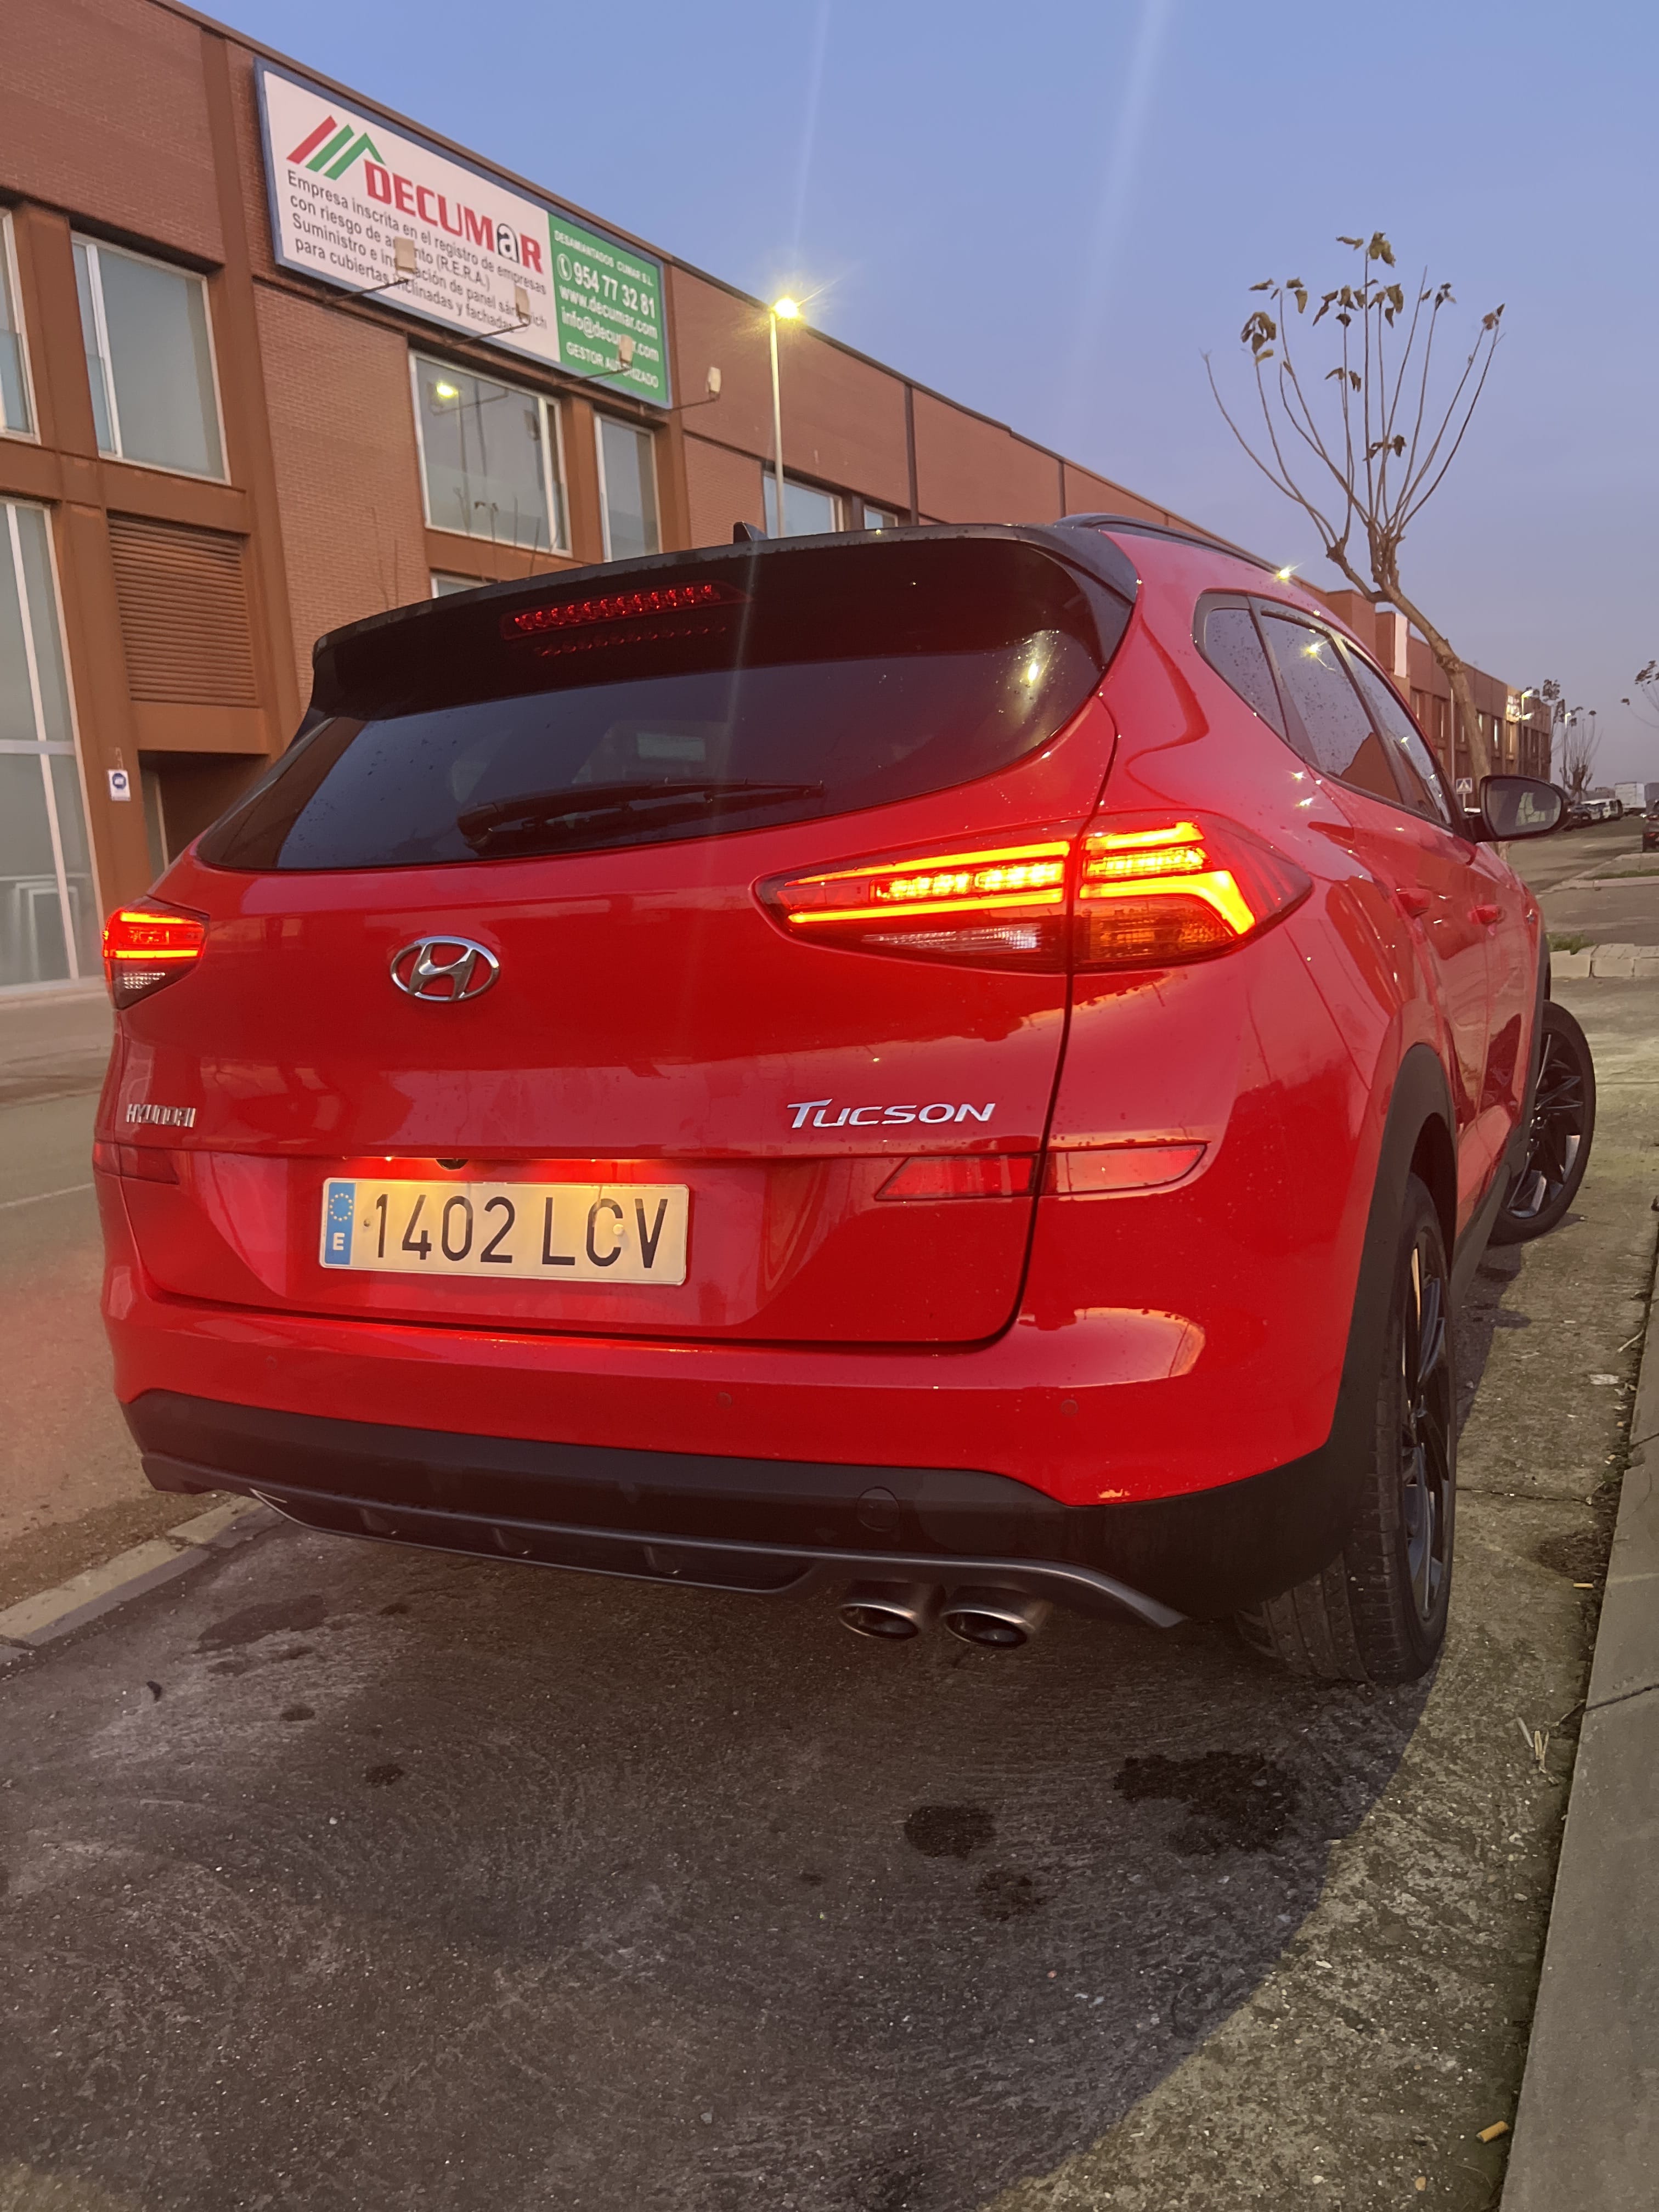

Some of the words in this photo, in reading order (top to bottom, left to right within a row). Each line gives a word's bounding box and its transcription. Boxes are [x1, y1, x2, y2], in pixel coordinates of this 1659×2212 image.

[287, 169, 348, 210] Empresa
[352, 197, 399, 232] inscrita
[403, 224, 417, 240] en
[421, 227, 432, 246] el
[435, 238, 479, 266] registro
[481, 256, 494, 273] de
[497, 266, 546, 295] empresas
[290, 194, 317, 216] con
[320, 206, 362, 235] riesgo
[366, 225, 381, 243] de
[386, 235, 433, 264] anto
[292, 213, 366, 257] Suministro
[370, 249, 377, 261] e
[381, 248, 447, 290] inación
[450, 279, 464, 296] de
[467, 288, 496, 309] panel
[295, 237, 326, 261] para
[330, 251, 390, 286] cubiertas
[456, 301, 463, 317] y
[559, 285, 658, 340] www.decumar.com
[573, 262, 600, 293] 954
[602, 274, 618, 301] 77
[622, 284, 639, 311] 32
[640, 294, 655, 319] 81
[566, 341, 604, 368] GESTOR
[332, 1232, 345, 1251] E
[375, 1193, 516, 1264] 1402
[541, 1197, 668, 1269] LCV
